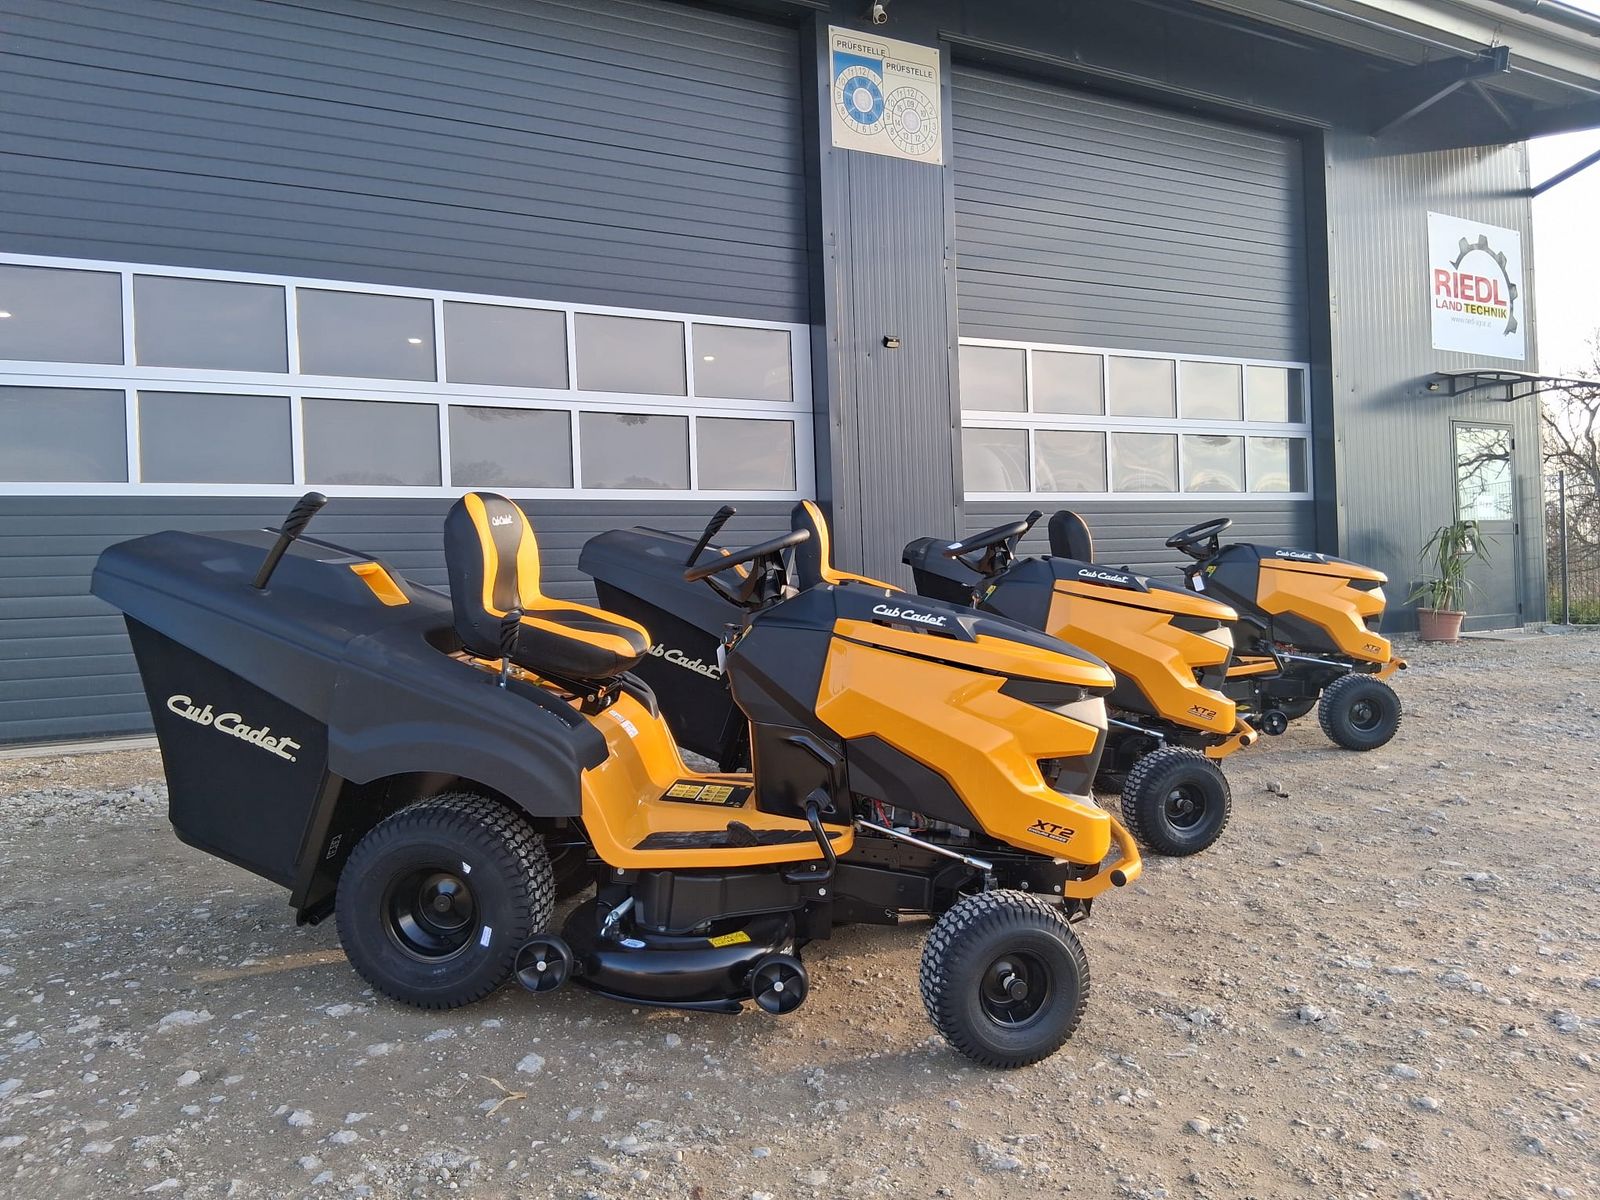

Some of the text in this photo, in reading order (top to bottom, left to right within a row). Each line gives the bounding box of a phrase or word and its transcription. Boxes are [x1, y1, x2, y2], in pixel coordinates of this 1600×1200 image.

[836, 40, 886, 57] PRÜFSTELLE
[886, 62, 933, 79] PRÜFSTELLE
[907, 88, 915, 98] 12
[1434, 268, 1507, 306] RIEDL
[1435, 298, 1507, 319] LAND TECHNIK
[1290, 551, 1313, 559] Cadet
[1078, 569, 1129, 584] Cub Cadet
[872, 604, 947, 627] Cub Cadet
[648, 643, 665, 657] ub
[1363, 643, 1382, 652] XT2
[1190, 704, 1217, 718] XT2
[166, 694, 301, 760] Cub Cadet
[1031, 819, 1075, 839] XT2
